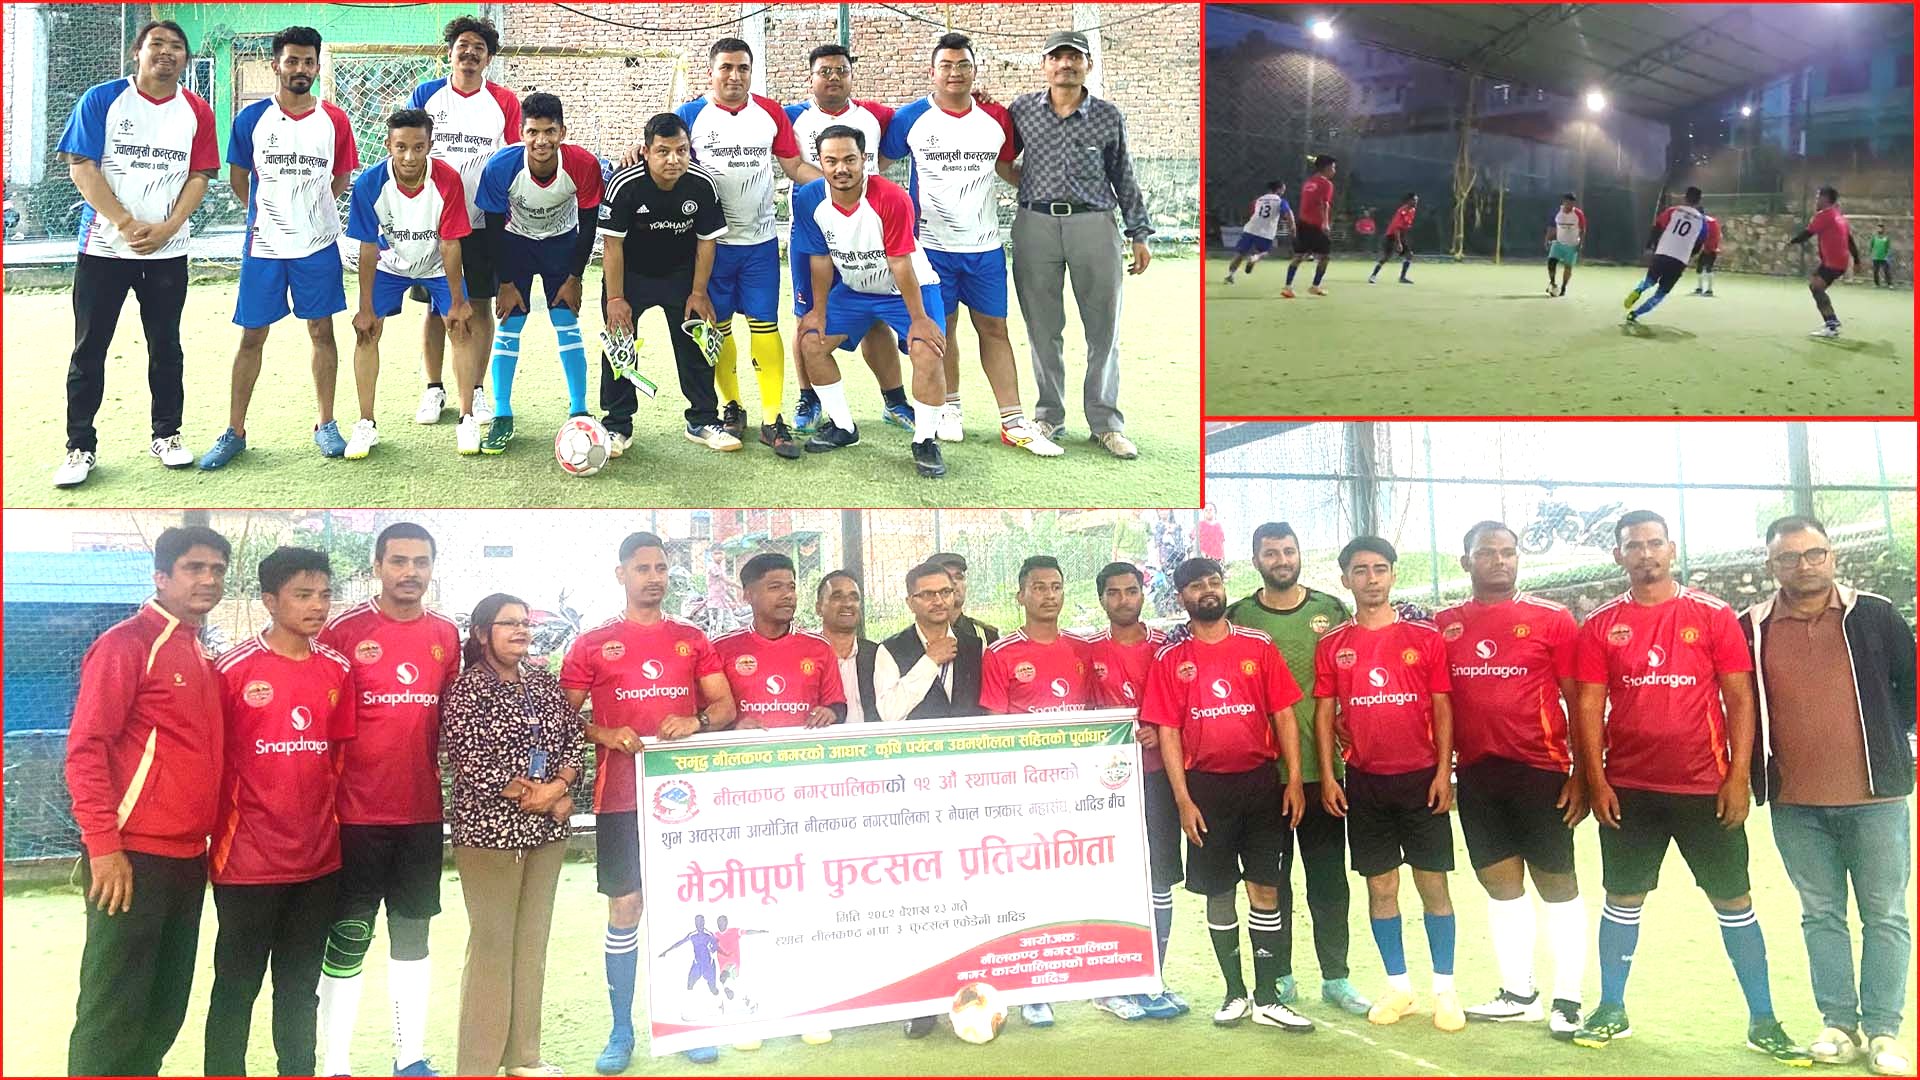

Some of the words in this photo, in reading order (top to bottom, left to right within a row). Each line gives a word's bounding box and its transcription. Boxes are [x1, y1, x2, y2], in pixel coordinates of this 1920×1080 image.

[924, 149, 961, 163] ज्वालामुखी
[1259, 205, 1271, 218] 13
[1672, 219, 1691, 236] 10
[615, 684, 689, 700] Snapdragon
[1349, 691, 1417, 707] napdragon
[740, 699, 809, 714] Snapdragon
[256, 736, 328, 756] Snapdrago
[713, 751, 772, 767] नीलकण्ठ
[777, 744, 824, 762] नगरको
[876, 739, 902, 758] कृषि
[906, 738, 944, 753] पर्यटन
[948, 735, 1015, 751] उद्यमशीलता
[1019, 730, 1066, 747] सहितको
[713, 788, 785, 806] नीलकण्ठ
[794, 775, 905, 800] नगरपालिकाको
[913, 777, 931, 791] १२
[965, 771, 1017, 788] स्थापना
[1024, 762, 1079, 785] दिवसको
[661, 831, 683, 850] शुभ
[688, 826, 740, 844] अवसरमा
[747, 818, 799, 839] आयोजित
[804, 816, 858, 834] नीलकण्ठ
[863, 808, 930, 828] नगरपालिका
[935, 810, 943, 824] र
[948, 805, 979, 821] नेपाल
[984, 803, 1023, 819] पत्रकार
[1075, 794, 1105, 812] धादिङ
[677, 853, 806, 905] मैत्रीपूर्ण
[822, 850, 943, 899] फुटसल
[958, 829, 1116, 881] प्रतियोगिता
[836, 910, 861, 924] मिति
[868, 909, 894, 921] २०८२
[934, 903, 947, 914] २३
[951, 899, 968, 912] गते
[811, 929, 862, 943] नीलकण्ठ
[896, 924, 903, 934] ३
[997, 910, 1026, 924] धादिङ
[980, 949, 1040, 964] नीलकण्ठ
[1043, 940, 1119, 957] नगरपालिका
[957, 968, 988, 981] नगर
[991, 958, 1083, 978] कार्यपालिकाको
[1087, 952, 1143, 967] कार्यालय
[1031, 971, 1070, 985] धादिङ
